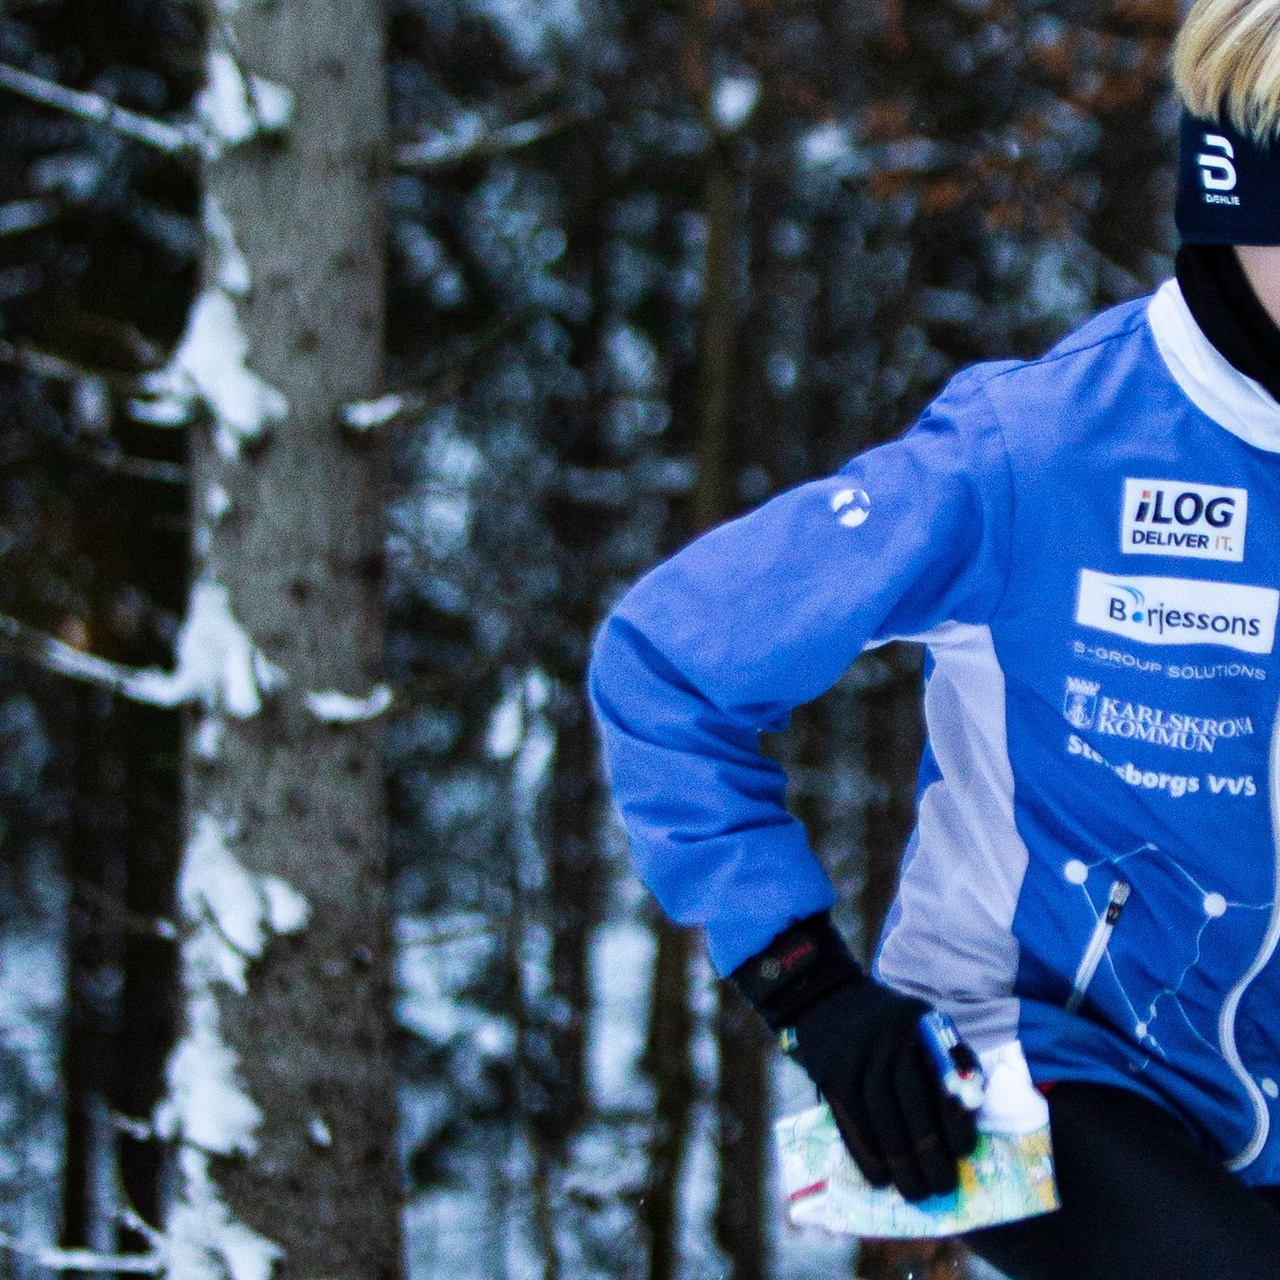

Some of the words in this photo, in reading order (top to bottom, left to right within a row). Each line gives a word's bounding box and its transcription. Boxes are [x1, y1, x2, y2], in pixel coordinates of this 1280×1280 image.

[1135, 489, 1236, 528] iLOG
[1132, 530, 1210, 549] DELIVER
[1215, 535, 1233, 551] IT.
[1072, 640, 1162, 672] S-GROUP
[1166, 663, 1267, 681] SOLUTIONS
[1098, 716, 1217, 753] KOMMUN
[1099, 696, 1254, 738] KARLSKRONA
